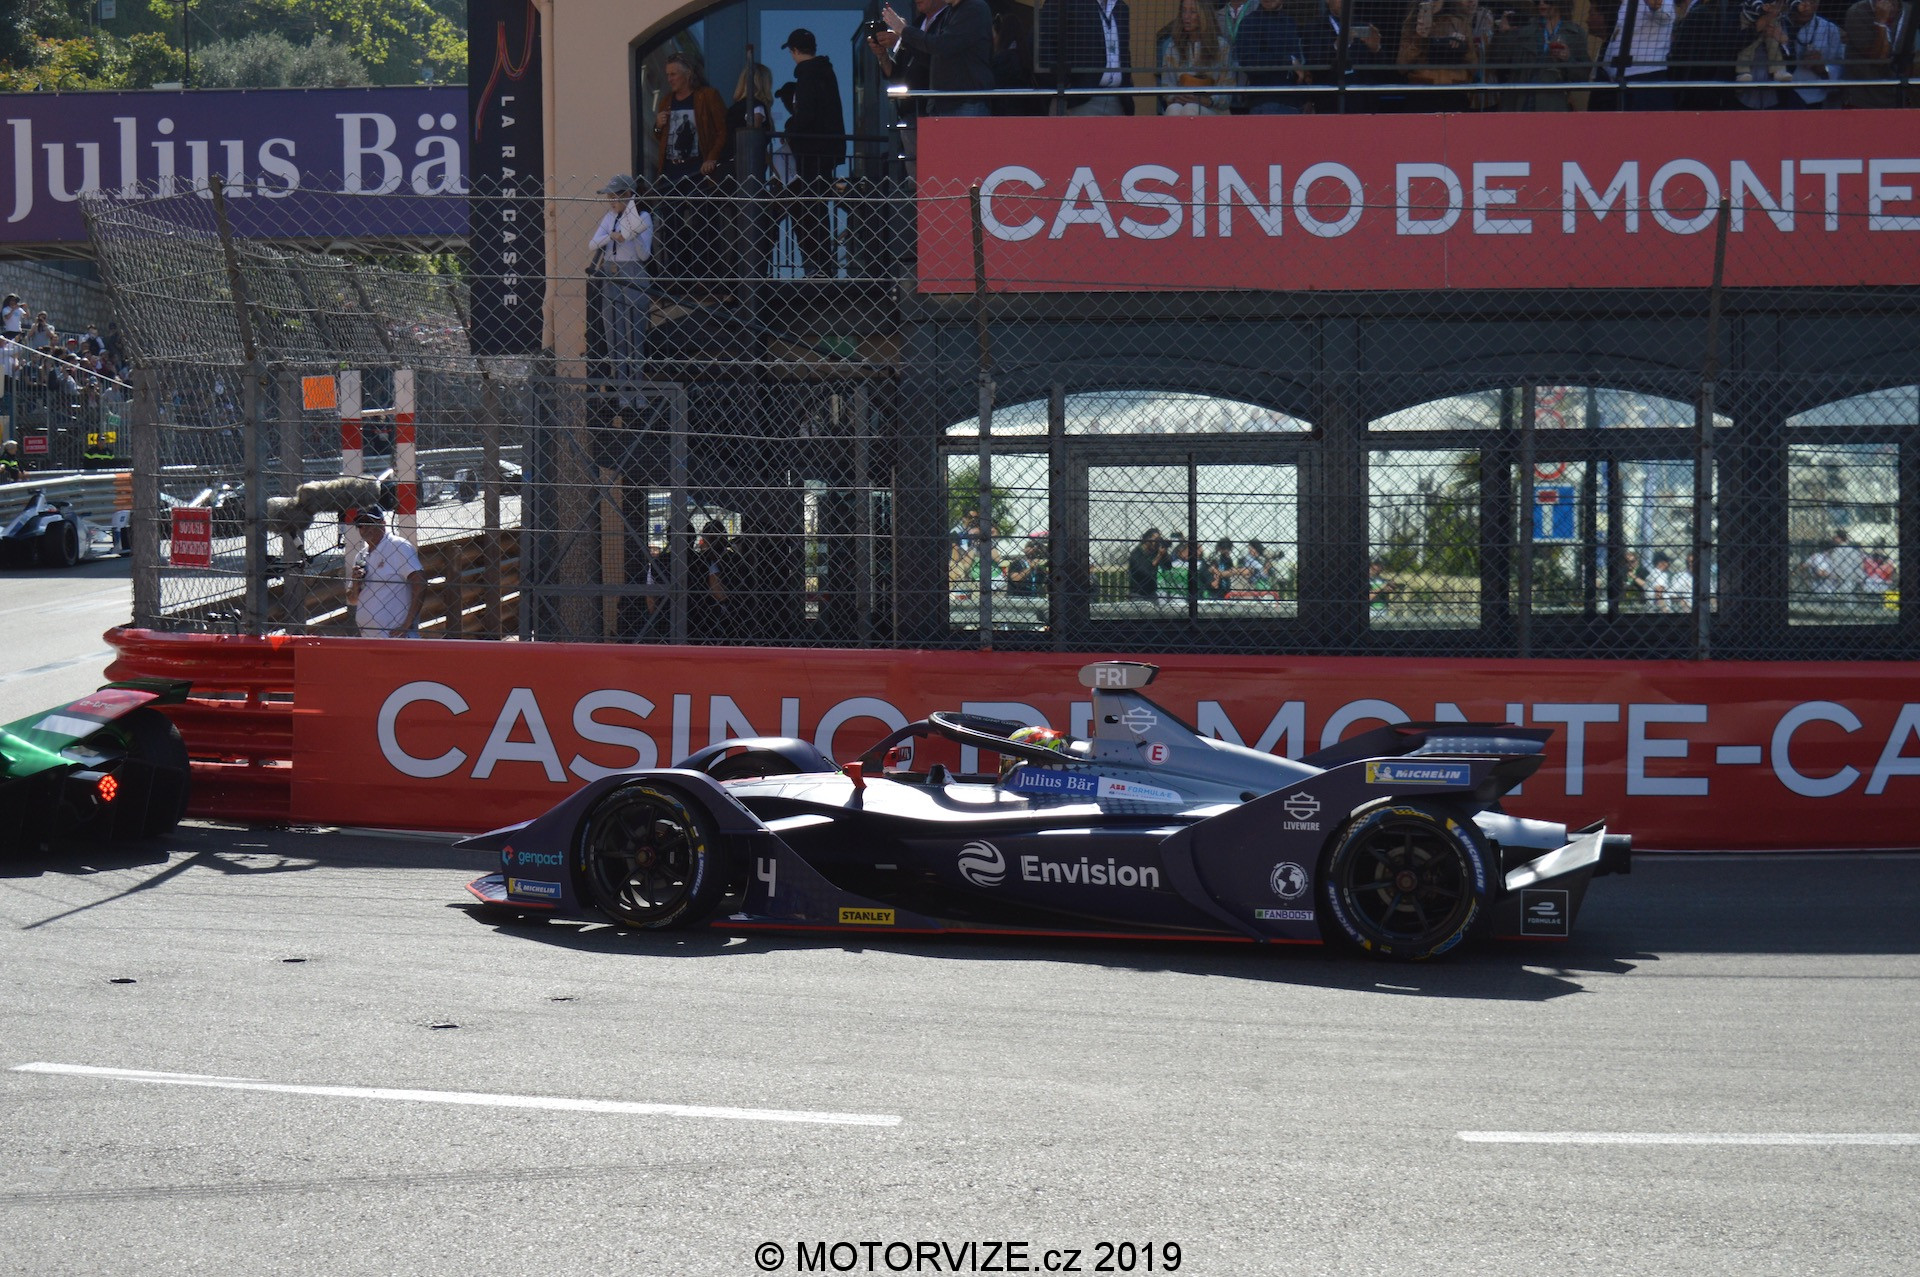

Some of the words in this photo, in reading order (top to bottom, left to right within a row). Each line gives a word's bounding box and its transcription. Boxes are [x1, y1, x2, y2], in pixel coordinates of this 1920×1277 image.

[501, 96, 516, 128] LA
[7, 117, 301, 223] Julius
[979, 164, 1364, 242] CASINO
[1396, 162, 1532, 235] DE
[1562, 158, 1920, 235] MONTE
[502, 145, 518, 306] RASCASSE
[1095, 667, 1127, 686] FRI
[376, 681, 913, 784] CASINO
[1151, 745, 1163, 761] E
[1019, 772, 1062, 790] Julius
[1066, 776, 1095, 791] Bär
[1395, 769, 1461, 779] MICHELIN
[1109, 783, 1126, 791] ABB
[1283, 821, 1320, 831] LIVEWIRE
[518, 851, 564, 867] genpact
[1460, 835, 1484, 888] MICHELIN
[757, 857, 777, 897] 4
[1020, 855, 1160, 888] Envision
[523, 884, 556, 894] MICHELIN
[842, 910, 891, 921] STANLEY
[1264, 910, 1312, 920] FANBOOST
[1328, 885, 1357, 936] MICHELIN
